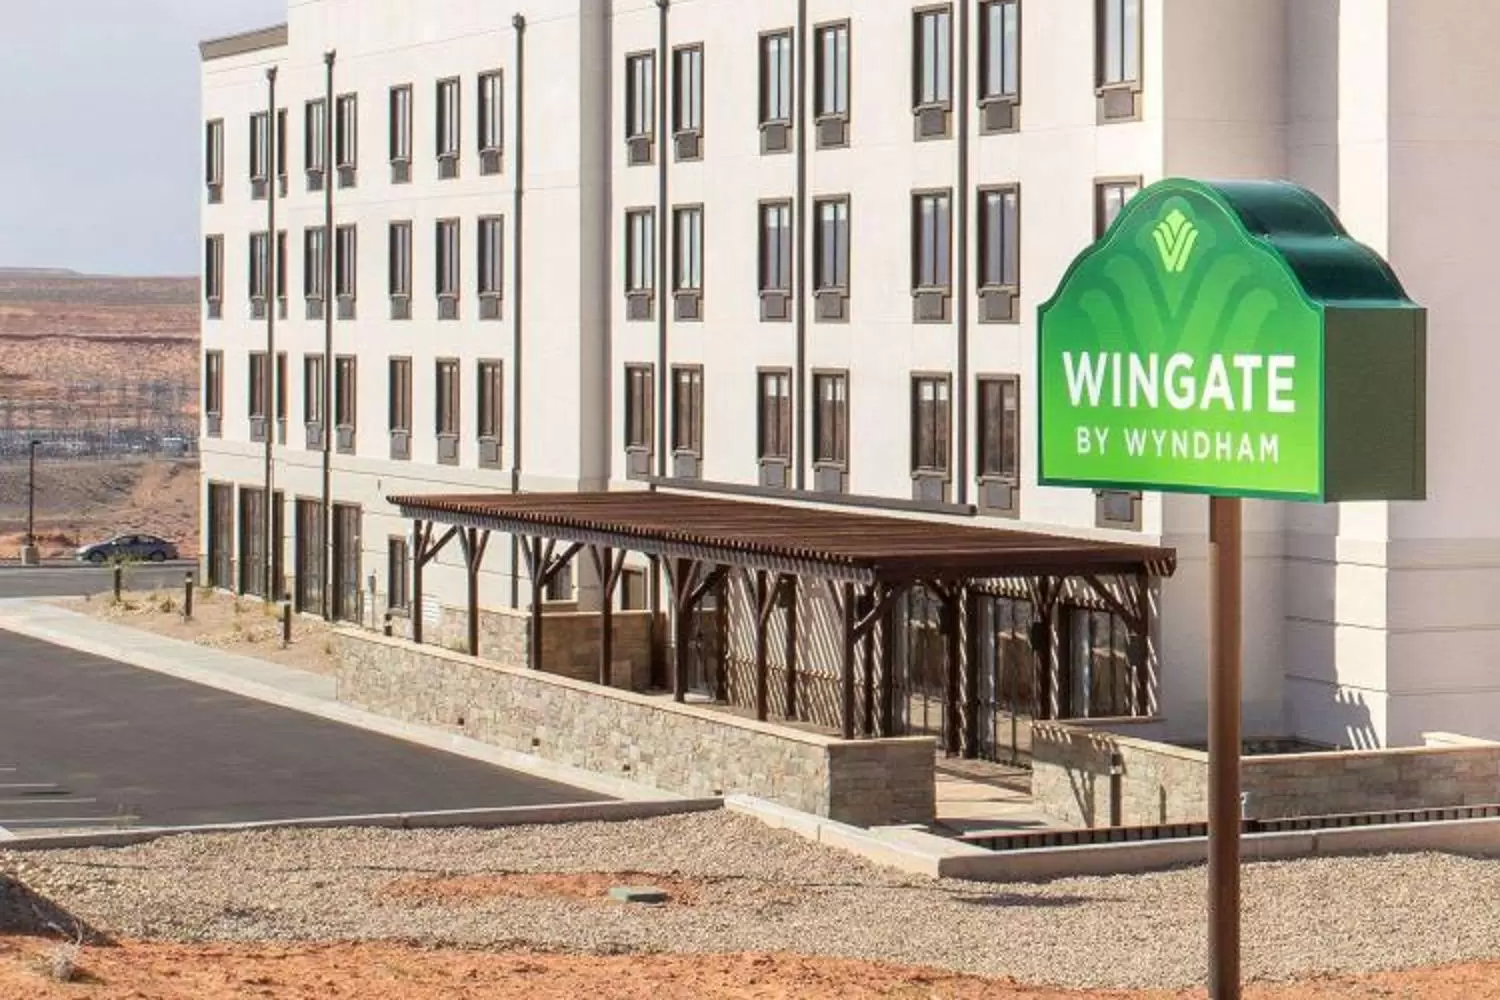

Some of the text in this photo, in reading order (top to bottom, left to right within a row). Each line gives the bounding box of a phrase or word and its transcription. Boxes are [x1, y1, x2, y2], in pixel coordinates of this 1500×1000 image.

[1062, 351, 1296, 413] WINGATE
[1076, 426, 1280, 463] BY WYNDHAM
